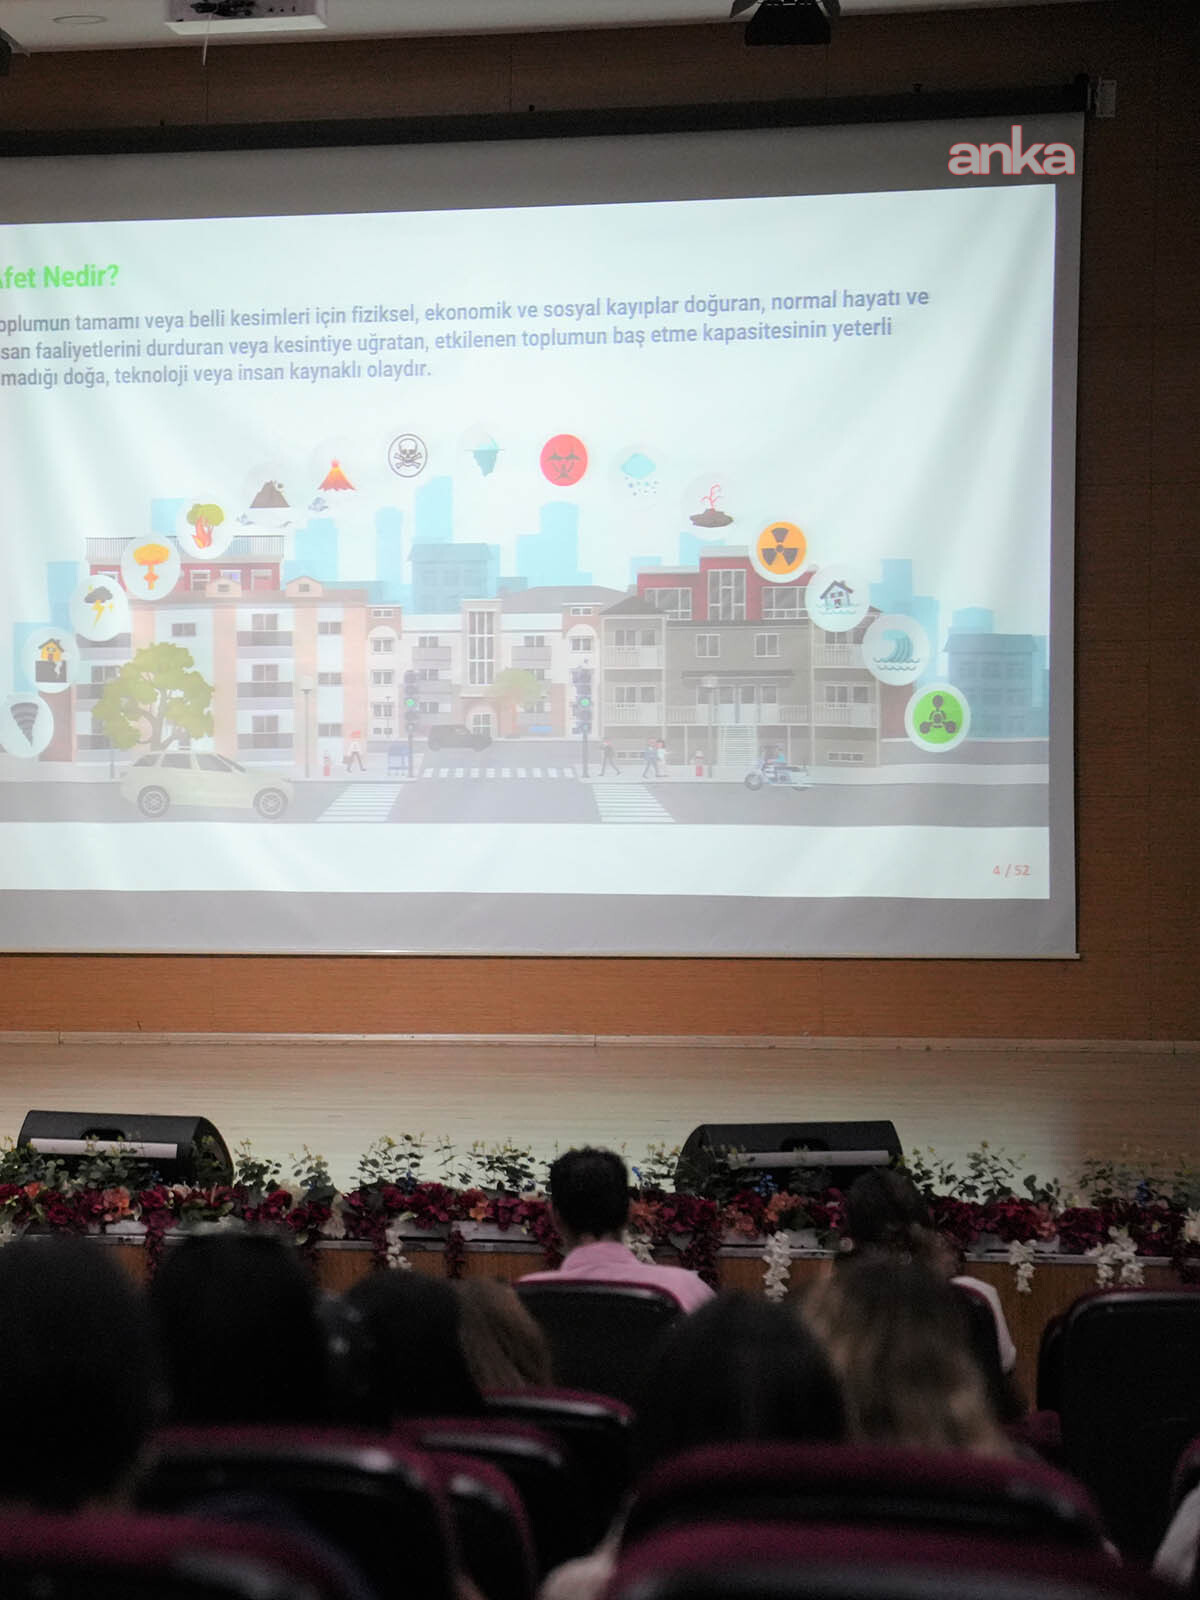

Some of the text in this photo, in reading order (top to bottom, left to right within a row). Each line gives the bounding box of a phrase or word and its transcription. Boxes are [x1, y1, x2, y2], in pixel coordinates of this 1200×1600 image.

[43, 263, 120, 288] Nedir?
[75, 314, 140, 331] tamamı
[144, 315, 184, 333] veya
[189, 309, 225, 328] belli
[230, 307, 310, 326] kesimleri
[315, 306, 346, 328] için
[351, 303, 419, 324] fiziksel,
[425, 300, 512, 321] ekonomik
[517, 304, 538, 318] ve
[543, 297, 601, 321] sosyal
[606, 295, 679, 320] kayıplar
[684, 293, 766, 318] doğuran,
[771, 289, 837, 311] normal
[842, 289, 900, 312] hayatı
[906, 290, 930, 305] ve
[36, 339, 141, 362] faaliyetlerini
[146, 338, 224, 356] durduran
[228, 340, 269, 359] veya
[274, 335, 353, 357] kesintiye
[357, 332, 429, 355] uğratan,
[434, 329, 516, 349] etkilenen
[521, 327, 607, 351] toplumun
[613, 325, 646, 348] baş
[651, 326, 697, 343] etme
[702, 320, 827, 345] kapasitesinin
[831, 316, 892, 342] yeterli
[63, 366, 109, 389] doğa,
[114, 363, 188, 387] teknoloji
[193, 367, 233, 386] veya
[238, 363, 285, 381] insan
[289, 359, 361, 384] kaynaklı
[367, 359, 432, 382] olaydır.
